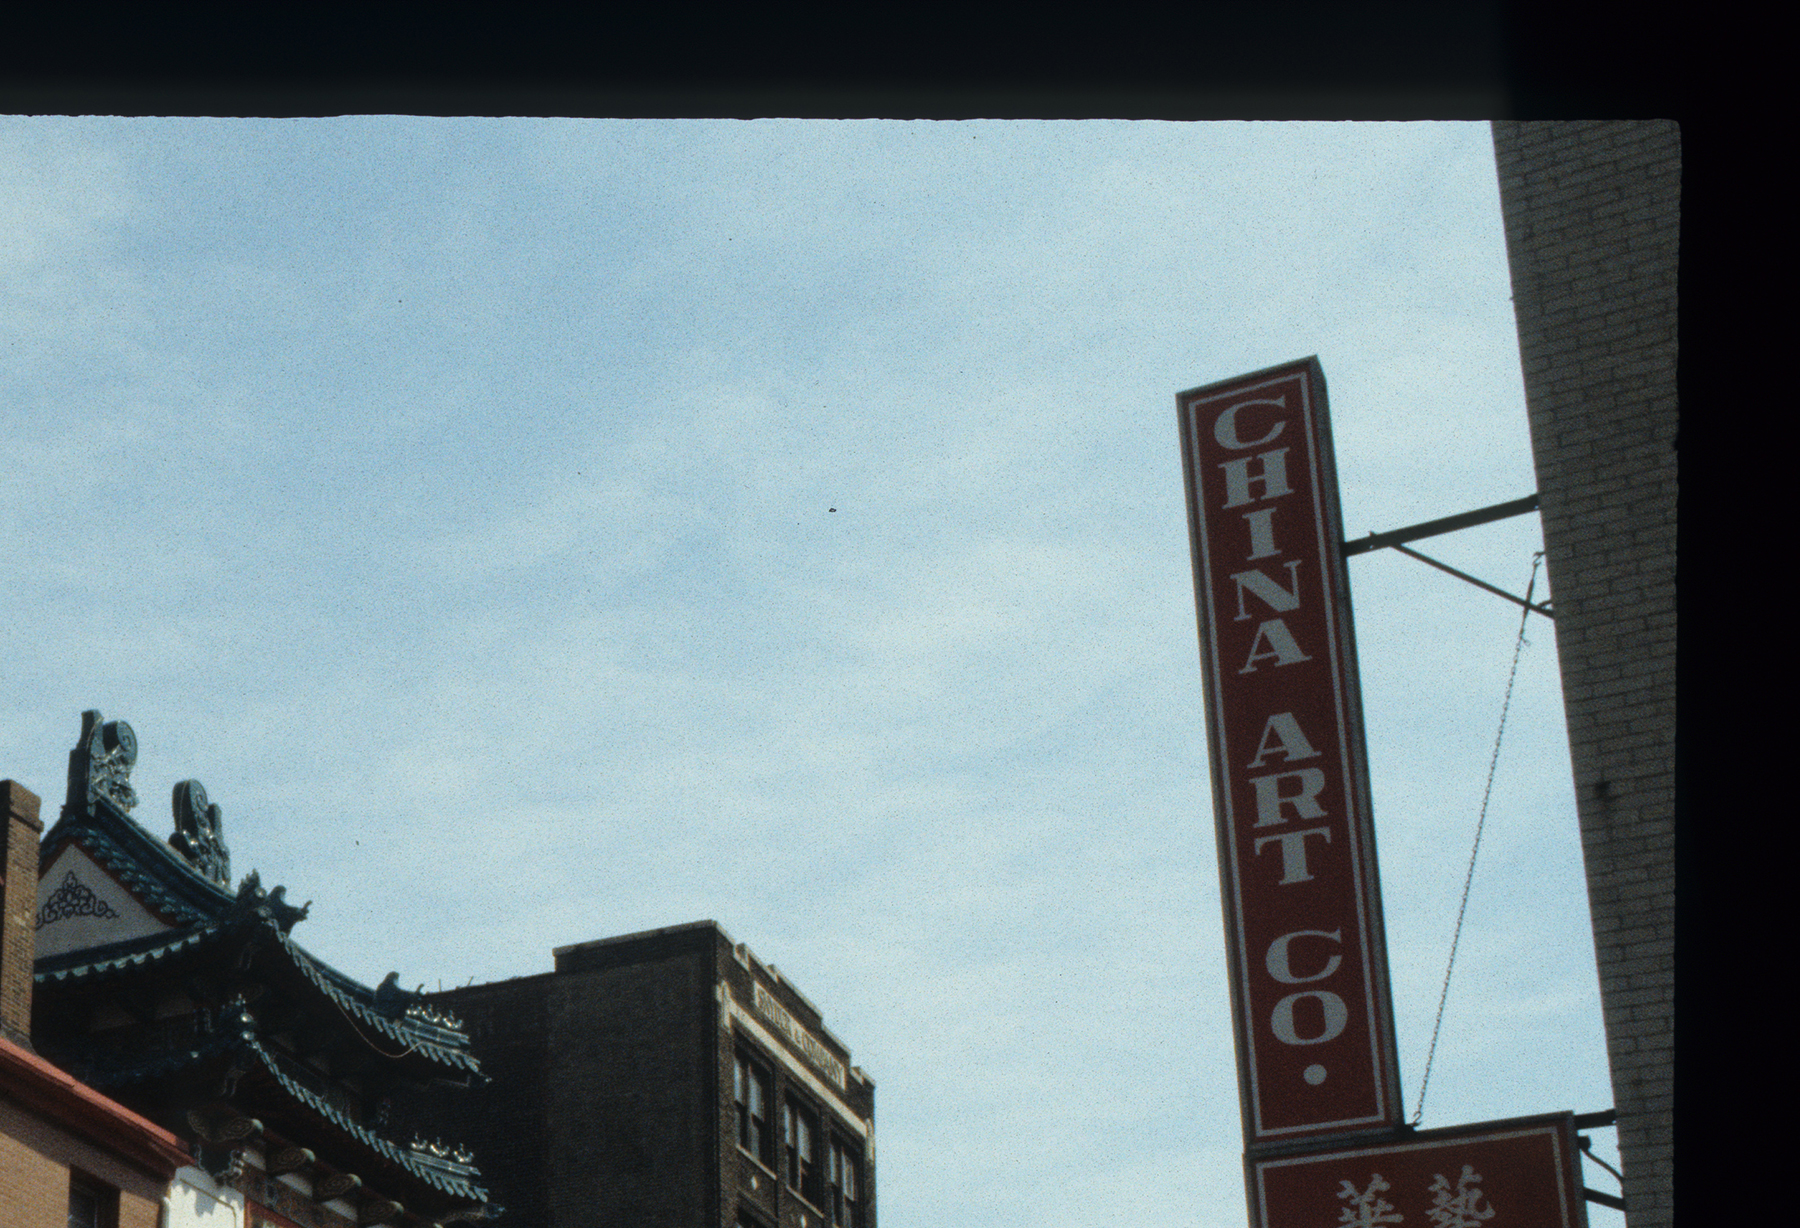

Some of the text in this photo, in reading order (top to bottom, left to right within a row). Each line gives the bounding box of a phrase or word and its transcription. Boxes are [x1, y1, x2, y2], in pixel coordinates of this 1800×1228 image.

[1213, 395, 1349, 1087] CHINA ART CO.
